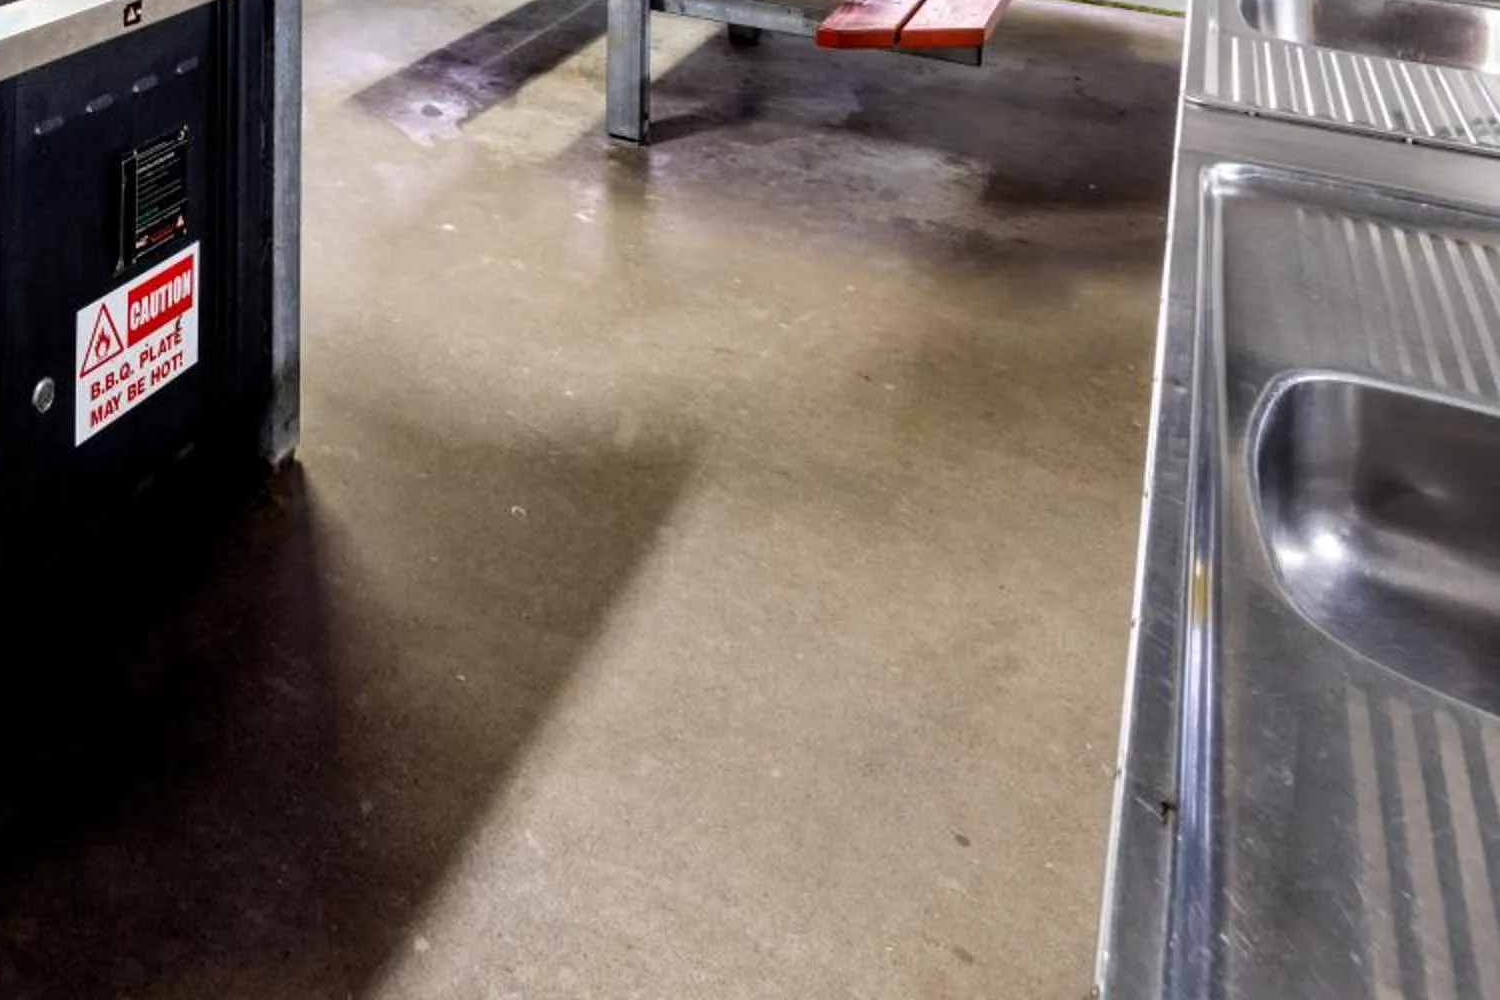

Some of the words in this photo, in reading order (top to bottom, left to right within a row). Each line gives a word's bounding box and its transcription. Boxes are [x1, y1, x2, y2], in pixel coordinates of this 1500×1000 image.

[130, 269, 192, 331] CAUTION
[90, 362, 134, 400] B.B.Q.
[139, 331, 183, 368] PLATE
[90, 392, 123, 428] MAY
[127, 376, 146, 401] BE
[151, 350, 184, 386] HOT!
